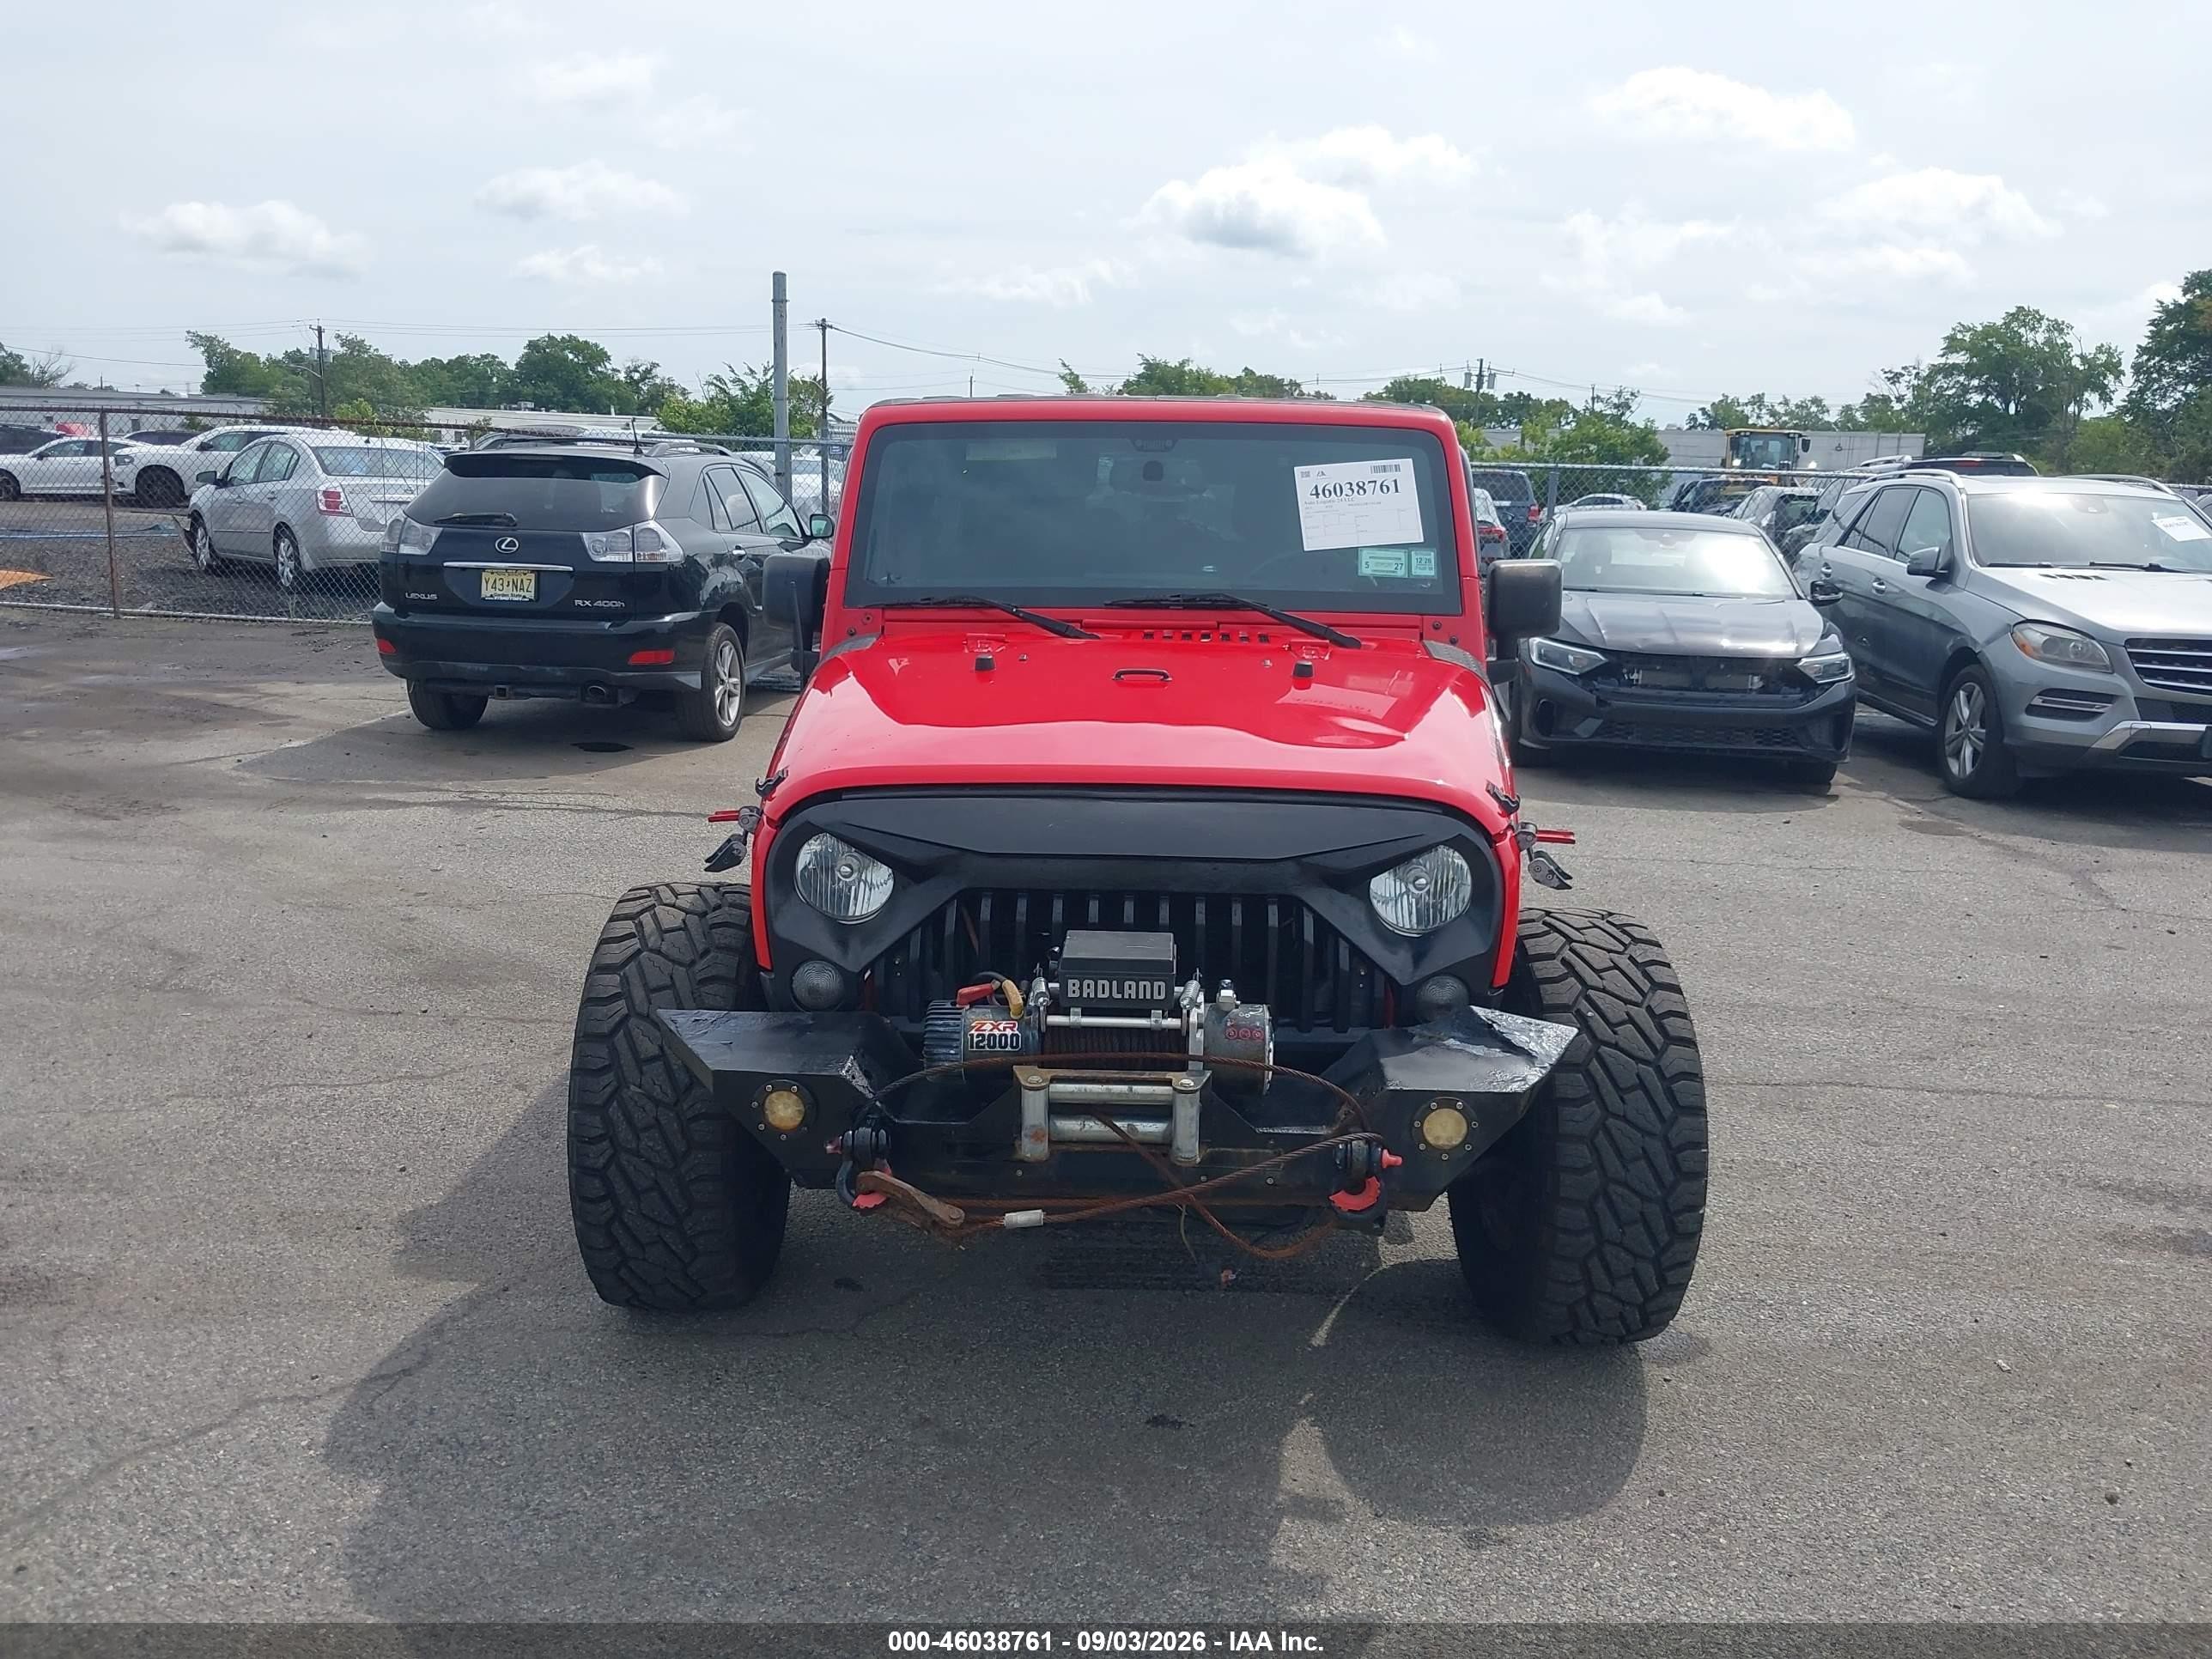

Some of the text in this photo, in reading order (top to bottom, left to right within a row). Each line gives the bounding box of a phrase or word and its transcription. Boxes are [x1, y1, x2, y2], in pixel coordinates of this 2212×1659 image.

[1310, 478, 1401, 499] 46038761
[484, 576, 532, 592] Y43 NAZ
[405, 592, 438, 600] LEXUS
[1067, 979, 1166, 1000] BADLAND
[968, 1021, 1018, 1032] ZXR
[968, 1032, 1022, 1050] 12000
